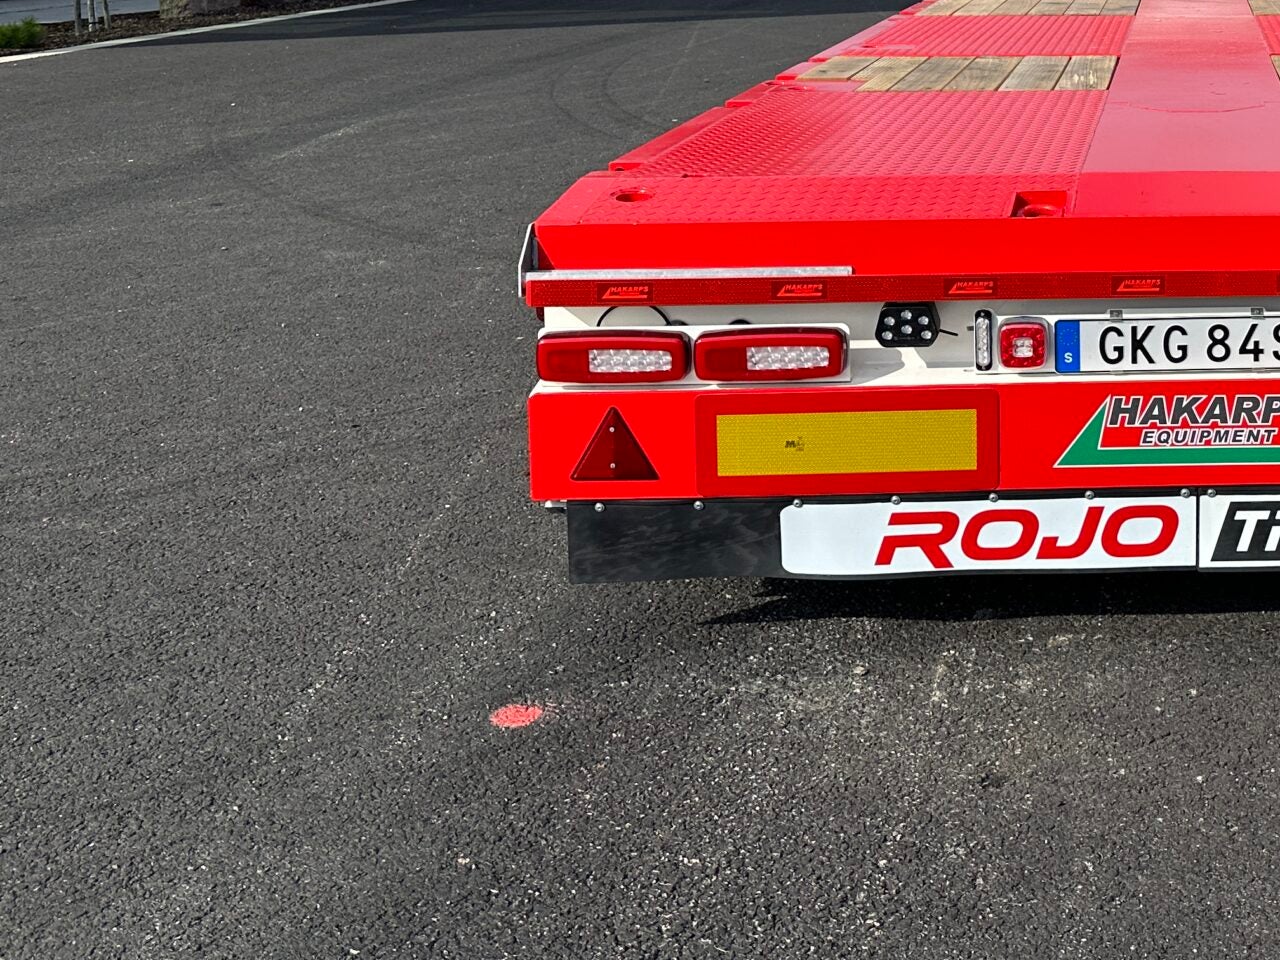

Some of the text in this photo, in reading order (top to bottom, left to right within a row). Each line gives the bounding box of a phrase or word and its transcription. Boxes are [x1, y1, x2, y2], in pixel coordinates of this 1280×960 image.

[1064, 352, 1073, 363] S
[1098, 324, 1188, 365] GKG
[1140, 427, 1278, 446] EQUIPMENT
[874, 504, 1180, 569] ROJO
